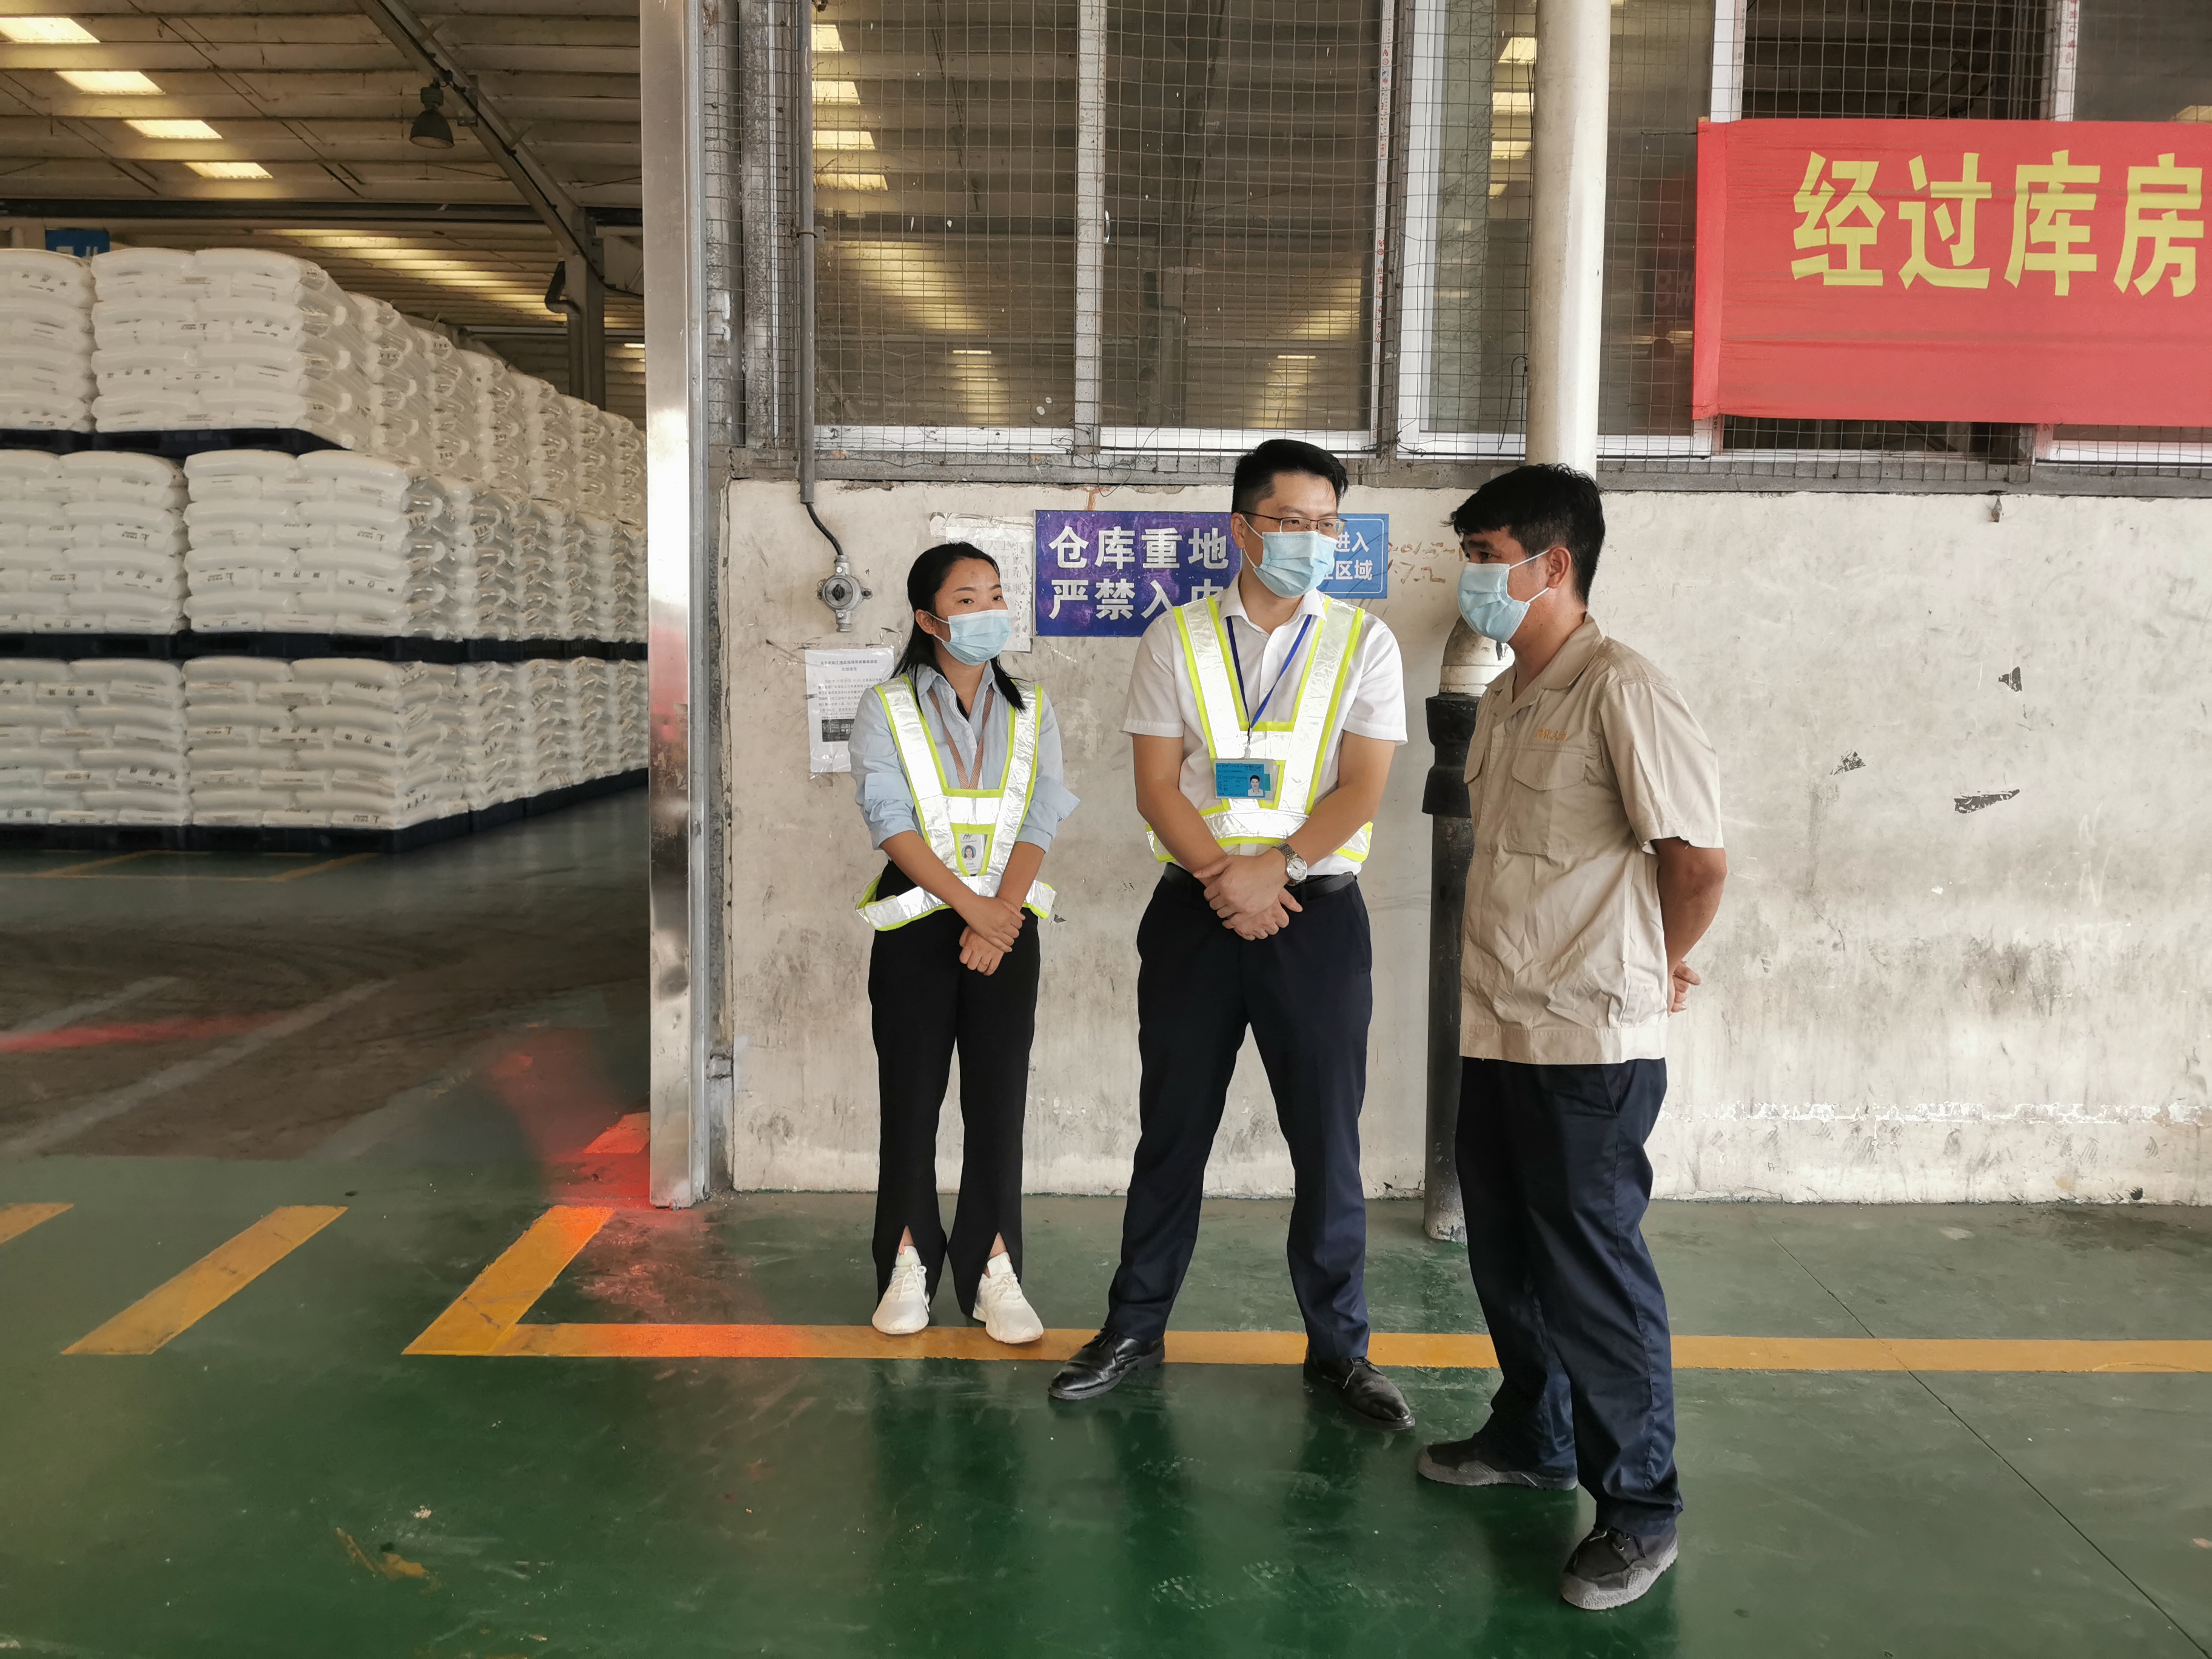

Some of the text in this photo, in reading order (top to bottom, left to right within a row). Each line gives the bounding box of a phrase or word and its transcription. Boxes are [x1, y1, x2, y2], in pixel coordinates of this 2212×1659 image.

[1791, 149, 2205, 297] 经过库房
[1048, 526, 1229, 570] 仓库重地
[1324, 559, 1373, 581] 区域
